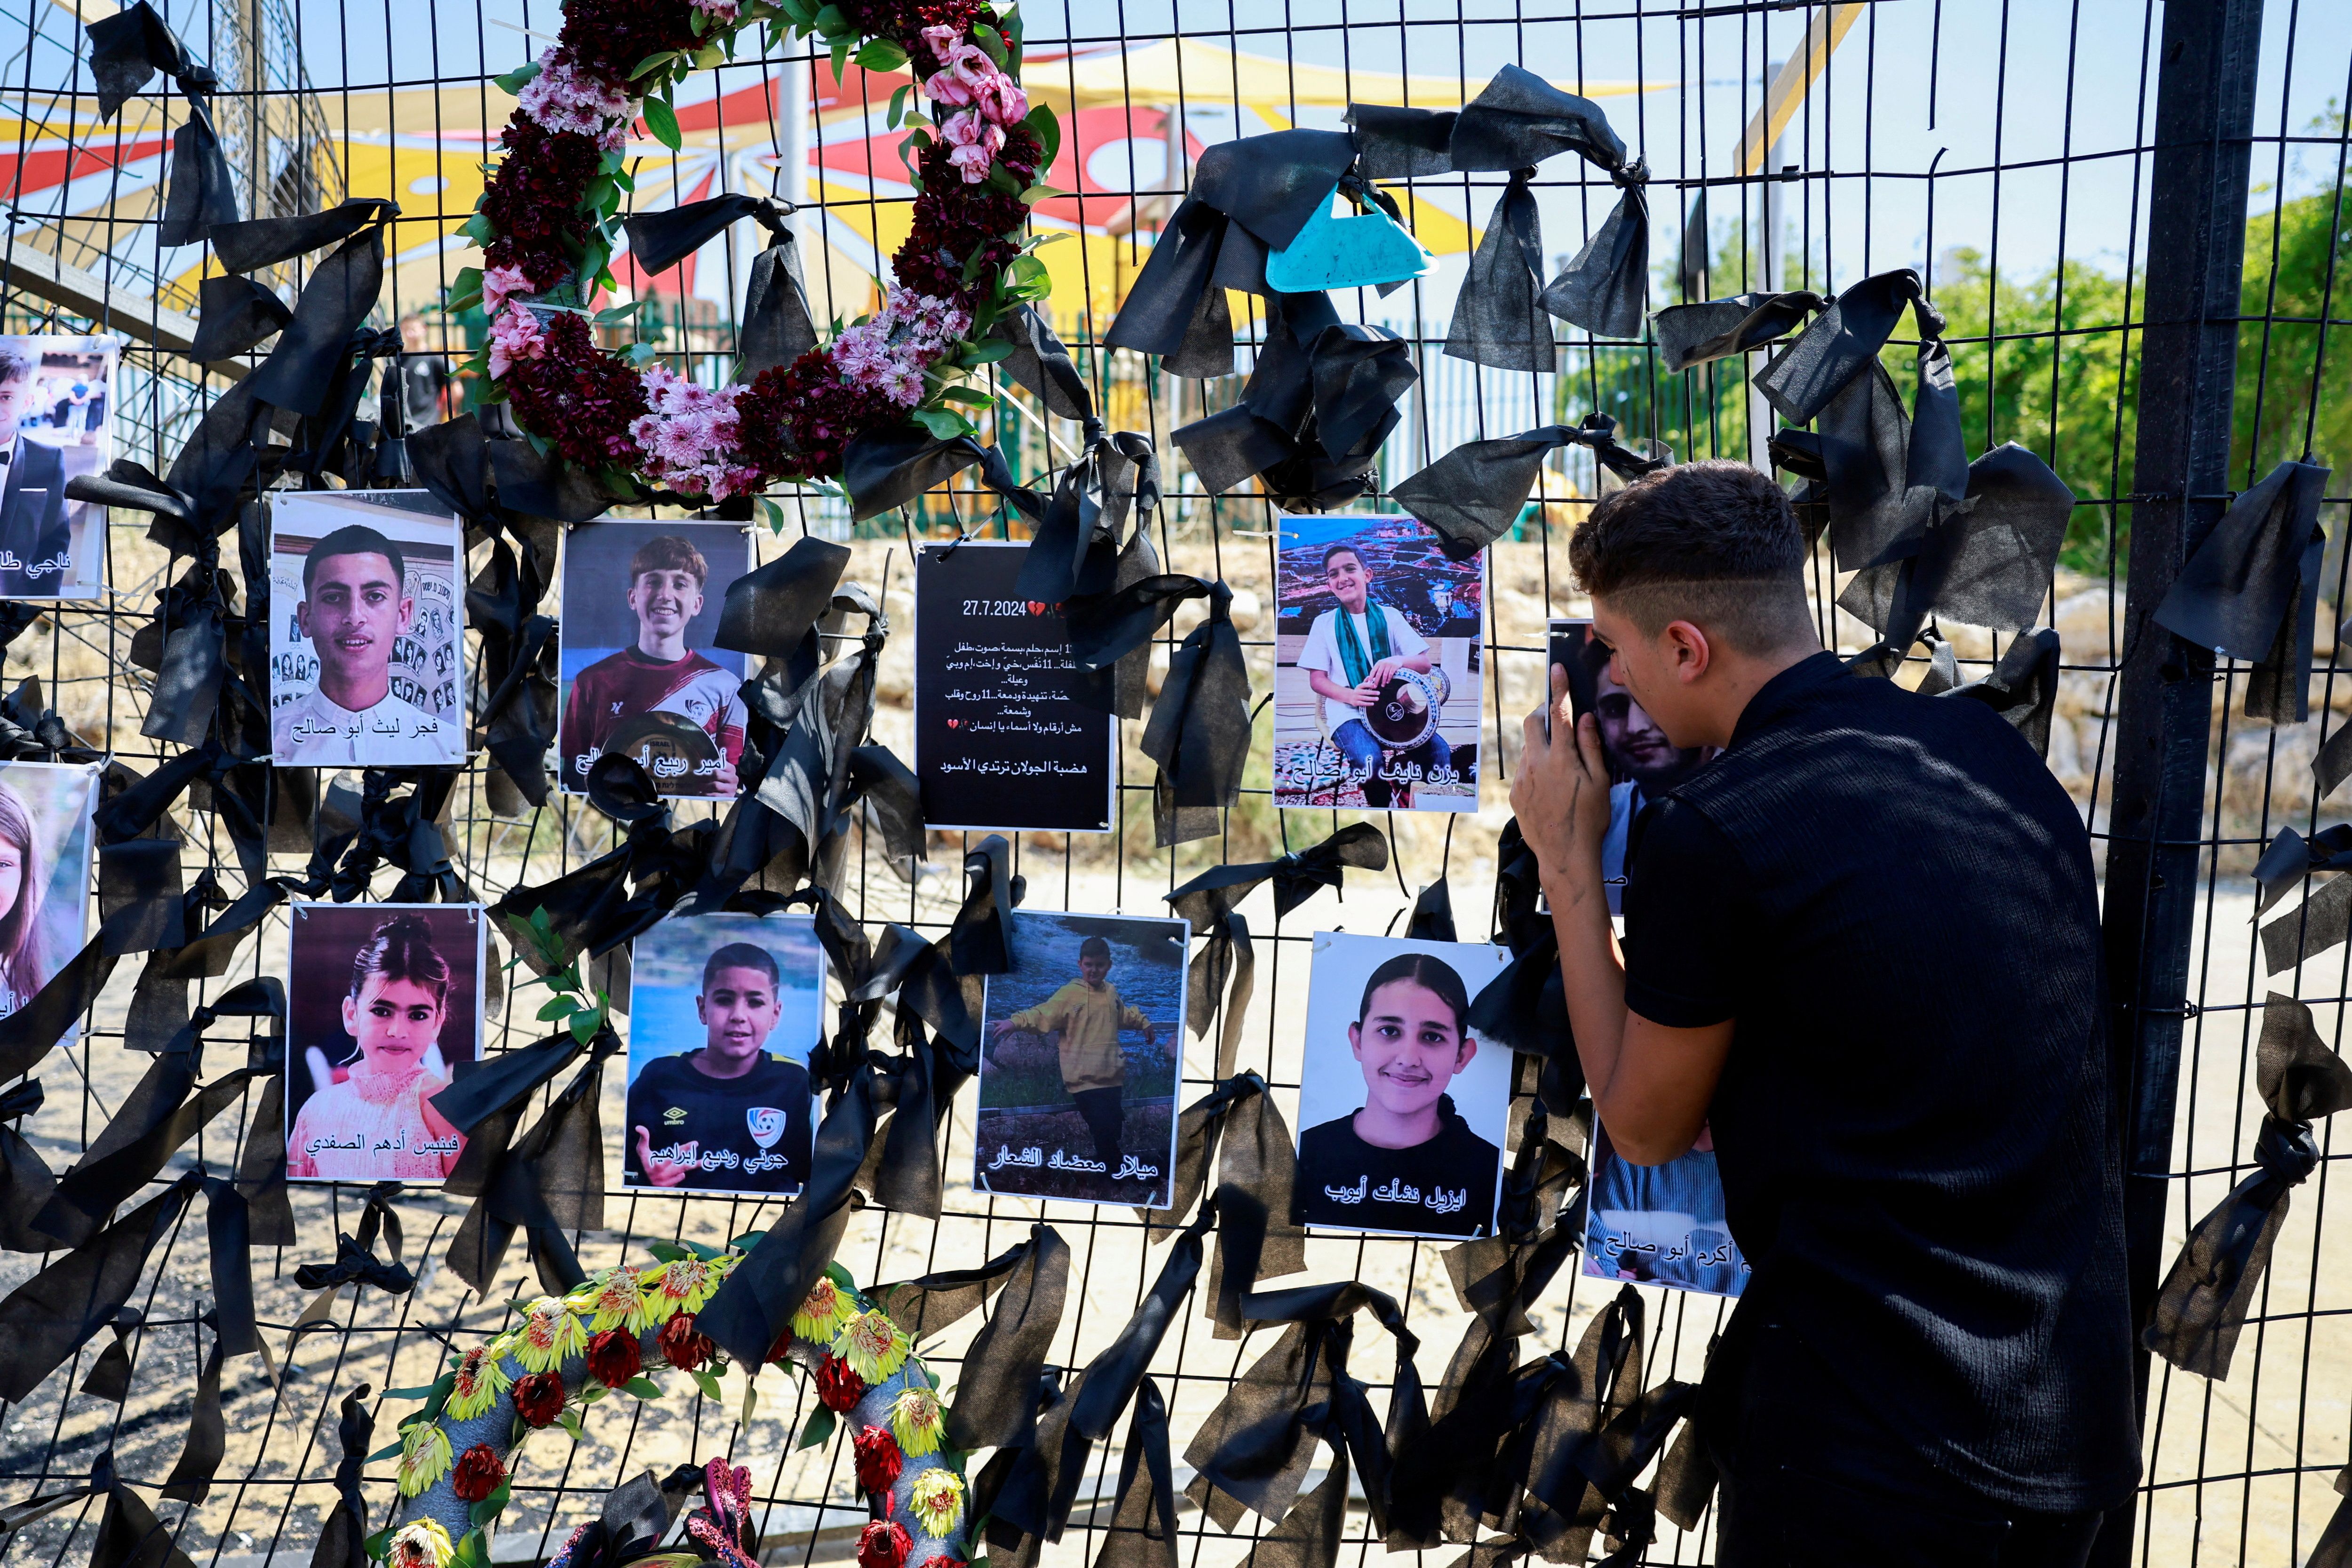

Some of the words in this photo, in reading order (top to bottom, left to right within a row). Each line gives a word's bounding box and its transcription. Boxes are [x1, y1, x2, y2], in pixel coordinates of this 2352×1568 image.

[27, 552, 70, 578] ناجي
[963, 600, 1026, 616] 27.7.2024
[945, 689, 964, 700] وقلب
[965, 691, 981, 701] روح
[1022, 690, 1048, 702] تنهيدة
[292, 718, 336, 743] صالح
[342, 713, 364, 739] أبو
[372, 717, 400, 738] ليث
[408, 718, 438, 739] فجر
[969, 720, 996, 732] إنسان
[998, 721, 1005, 732] يا
[1006, 720, 1031, 731] أسماء
[1033, 722, 1042, 733] ولا
[1043, 721, 1064, 735] أرقام
[1065, 724, 1081, 734] مش
[577, 748, 598, 773] الح
[655, 757, 687, 776] ربيع
[694, 748, 725, 774] أمير
[940, 756, 976, 773] الأسود
[977, 760, 1009, 774] ترتدي
[1011, 760, 1051, 775] الجولان
[1053, 760, 1088, 776] هضبة
[1349, 756, 1372, 782] أبو
[1294, 759, 1341, 784] صالح
[1379, 762, 1421, 782] نايف
[1429, 764, 1459, 785] يزن
[305, 1134, 365, 1156] الصفدي
[373, 1129, 405, 1157] أدهم
[413, 1135, 458, 1155] فينيس
[650, 1143, 696, 1166] إبراهيم
[703, 1150, 738, 1170] وديع
[745, 1150, 788, 1172] جوني
[989, 1146, 1041, 1168] الشعار
[1049, 1149, 1105, 1171] معضاد
[1112, 1155, 1157, 1179] ميلار
[1326, 1176, 1367, 1203] أيوب
[1373, 1178, 1420, 1202] نشأت
[1605, 1230, 1656, 1256] صالح
[1663, 1234, 1690, 1260] أبو
[1697, 1240, 1732, 1267] أكرم
